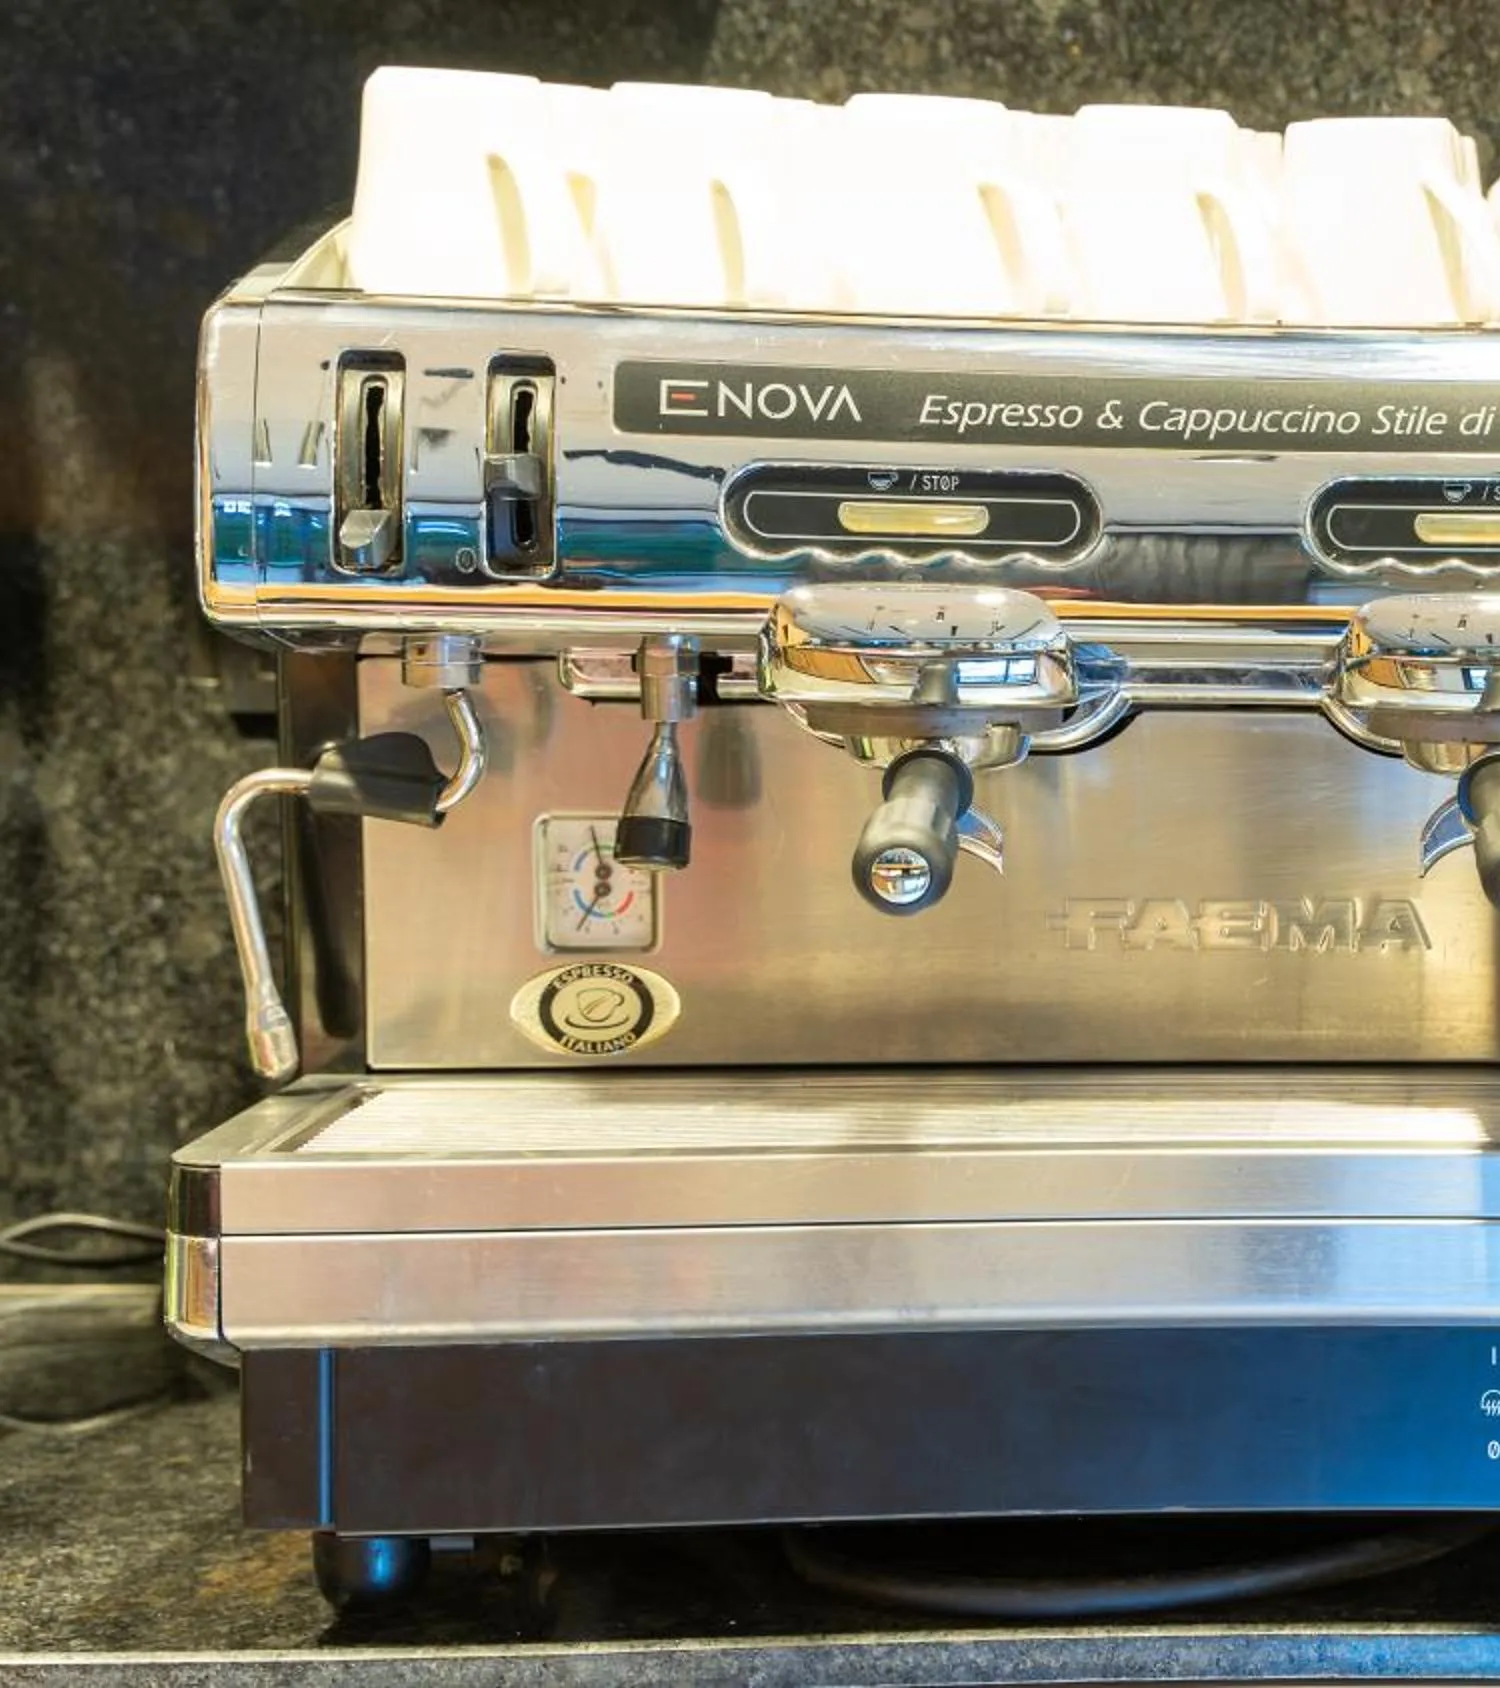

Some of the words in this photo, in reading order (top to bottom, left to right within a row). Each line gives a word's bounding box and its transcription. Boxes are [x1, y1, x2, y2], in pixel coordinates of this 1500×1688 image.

[659, 379, 862, 424] ENOVA
[918, 394, 1083, 435] Espresso
[1096, 402, 1123, 431] &
[1138, 401, 1360, 441] Cappuccino
[1371, 404, 1448, 437] Stile
[1459, 406, 1496, 437] di
[922, 475, 960, 491] STOP
[1063, 896, 1432, 952] FAEMA
[555, 964, 634, 990] ESPRESSO
[561, 1031, 637, 1054] ITALIANO
